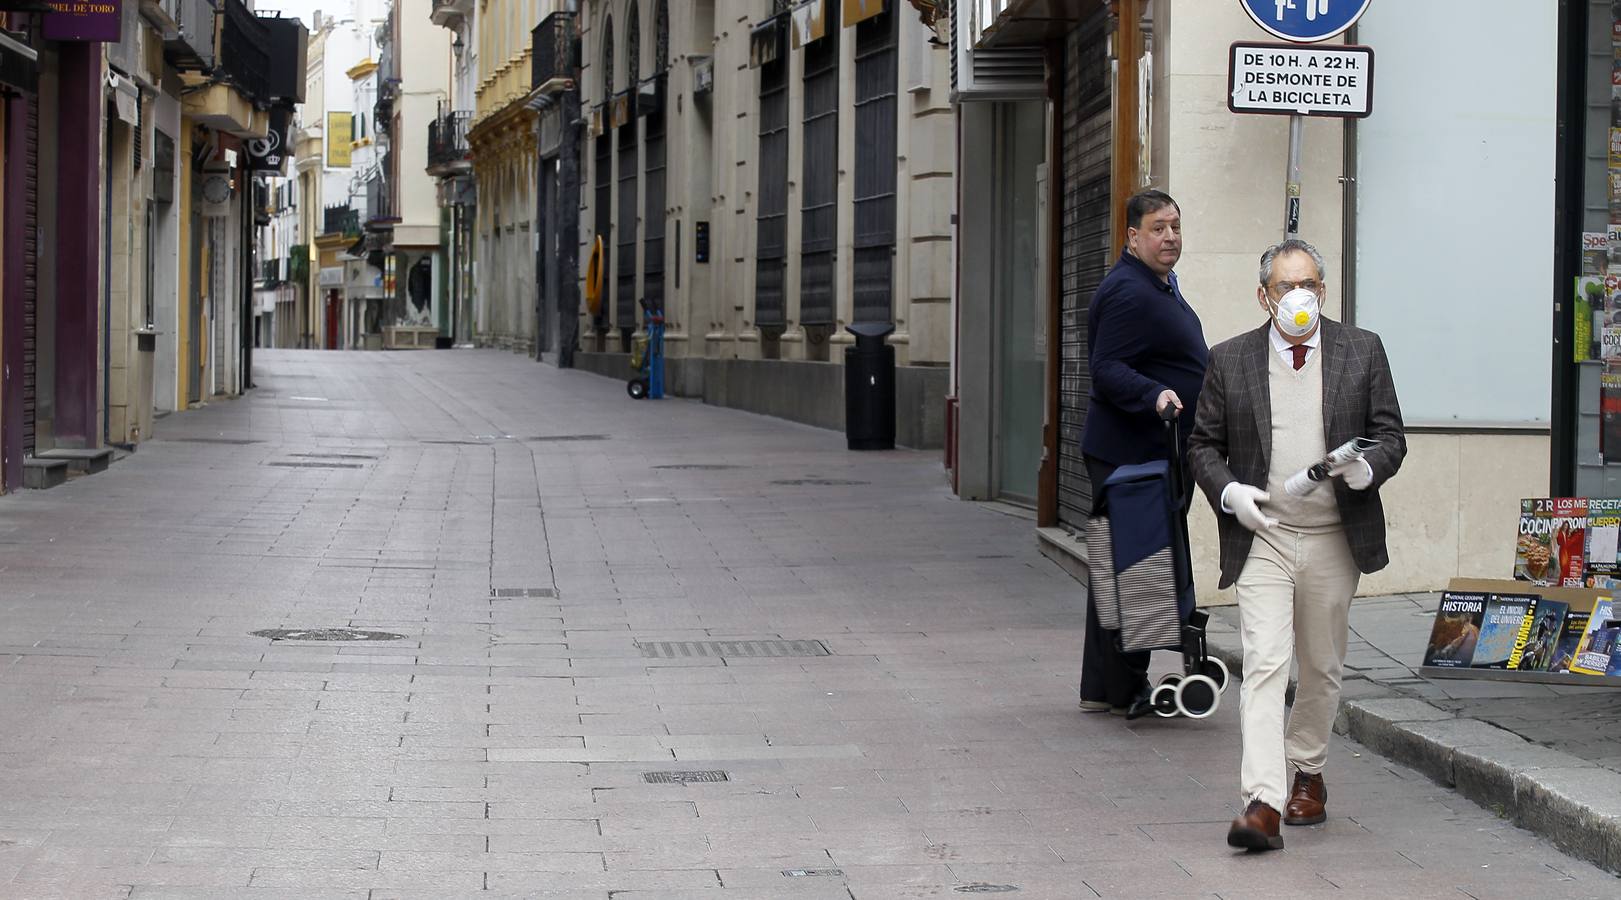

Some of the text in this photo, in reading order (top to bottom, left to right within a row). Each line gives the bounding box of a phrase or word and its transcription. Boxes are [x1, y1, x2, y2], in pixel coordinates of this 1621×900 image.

[73, 4, 87, 12] DE
[89, 5, 115, 13] TORO
[1244, 54, 1359, 69] DE 10 H. A 22 H.
[1245, 73, 1356, 87] DESMONTE DE
[1249, 91, 1351, 105] LA BICICLETA
[1536, 500, 1544, 511] 2
[1546, 500, 1554, 511] R
[1557, 500, 1572, 509] LOS
[1442, 602, 1482, 612] HISTORIA
[1507, 615, 1534, 669] WATCHMEN
